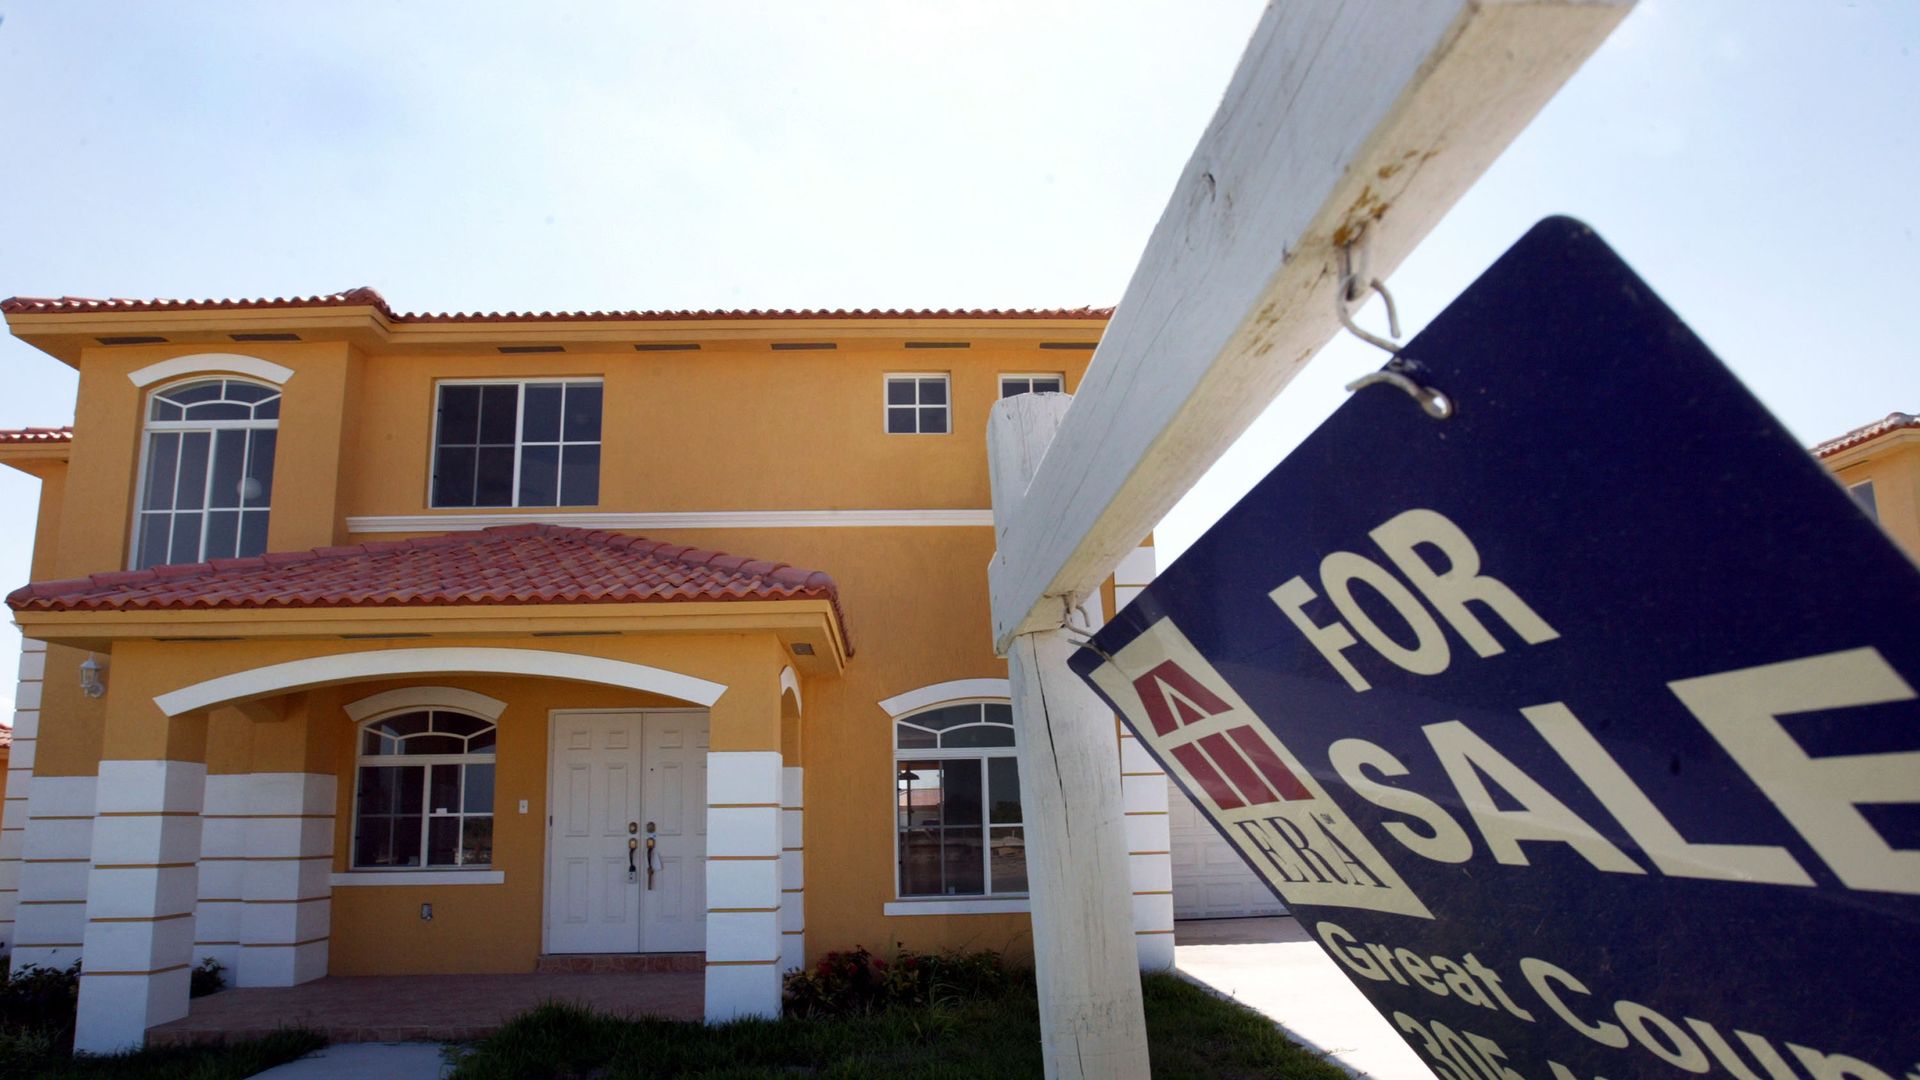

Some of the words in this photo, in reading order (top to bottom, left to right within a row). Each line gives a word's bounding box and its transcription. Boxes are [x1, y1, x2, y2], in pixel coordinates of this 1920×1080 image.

[1269, 508, 1560, 692] FOR
[1233, 811, 1392, 888] ERA
[1328, 646, 1920, 895] SALE
[1316, 921, 1536, 1022] Great
[1519, 957, 1920, 1080] Cou
